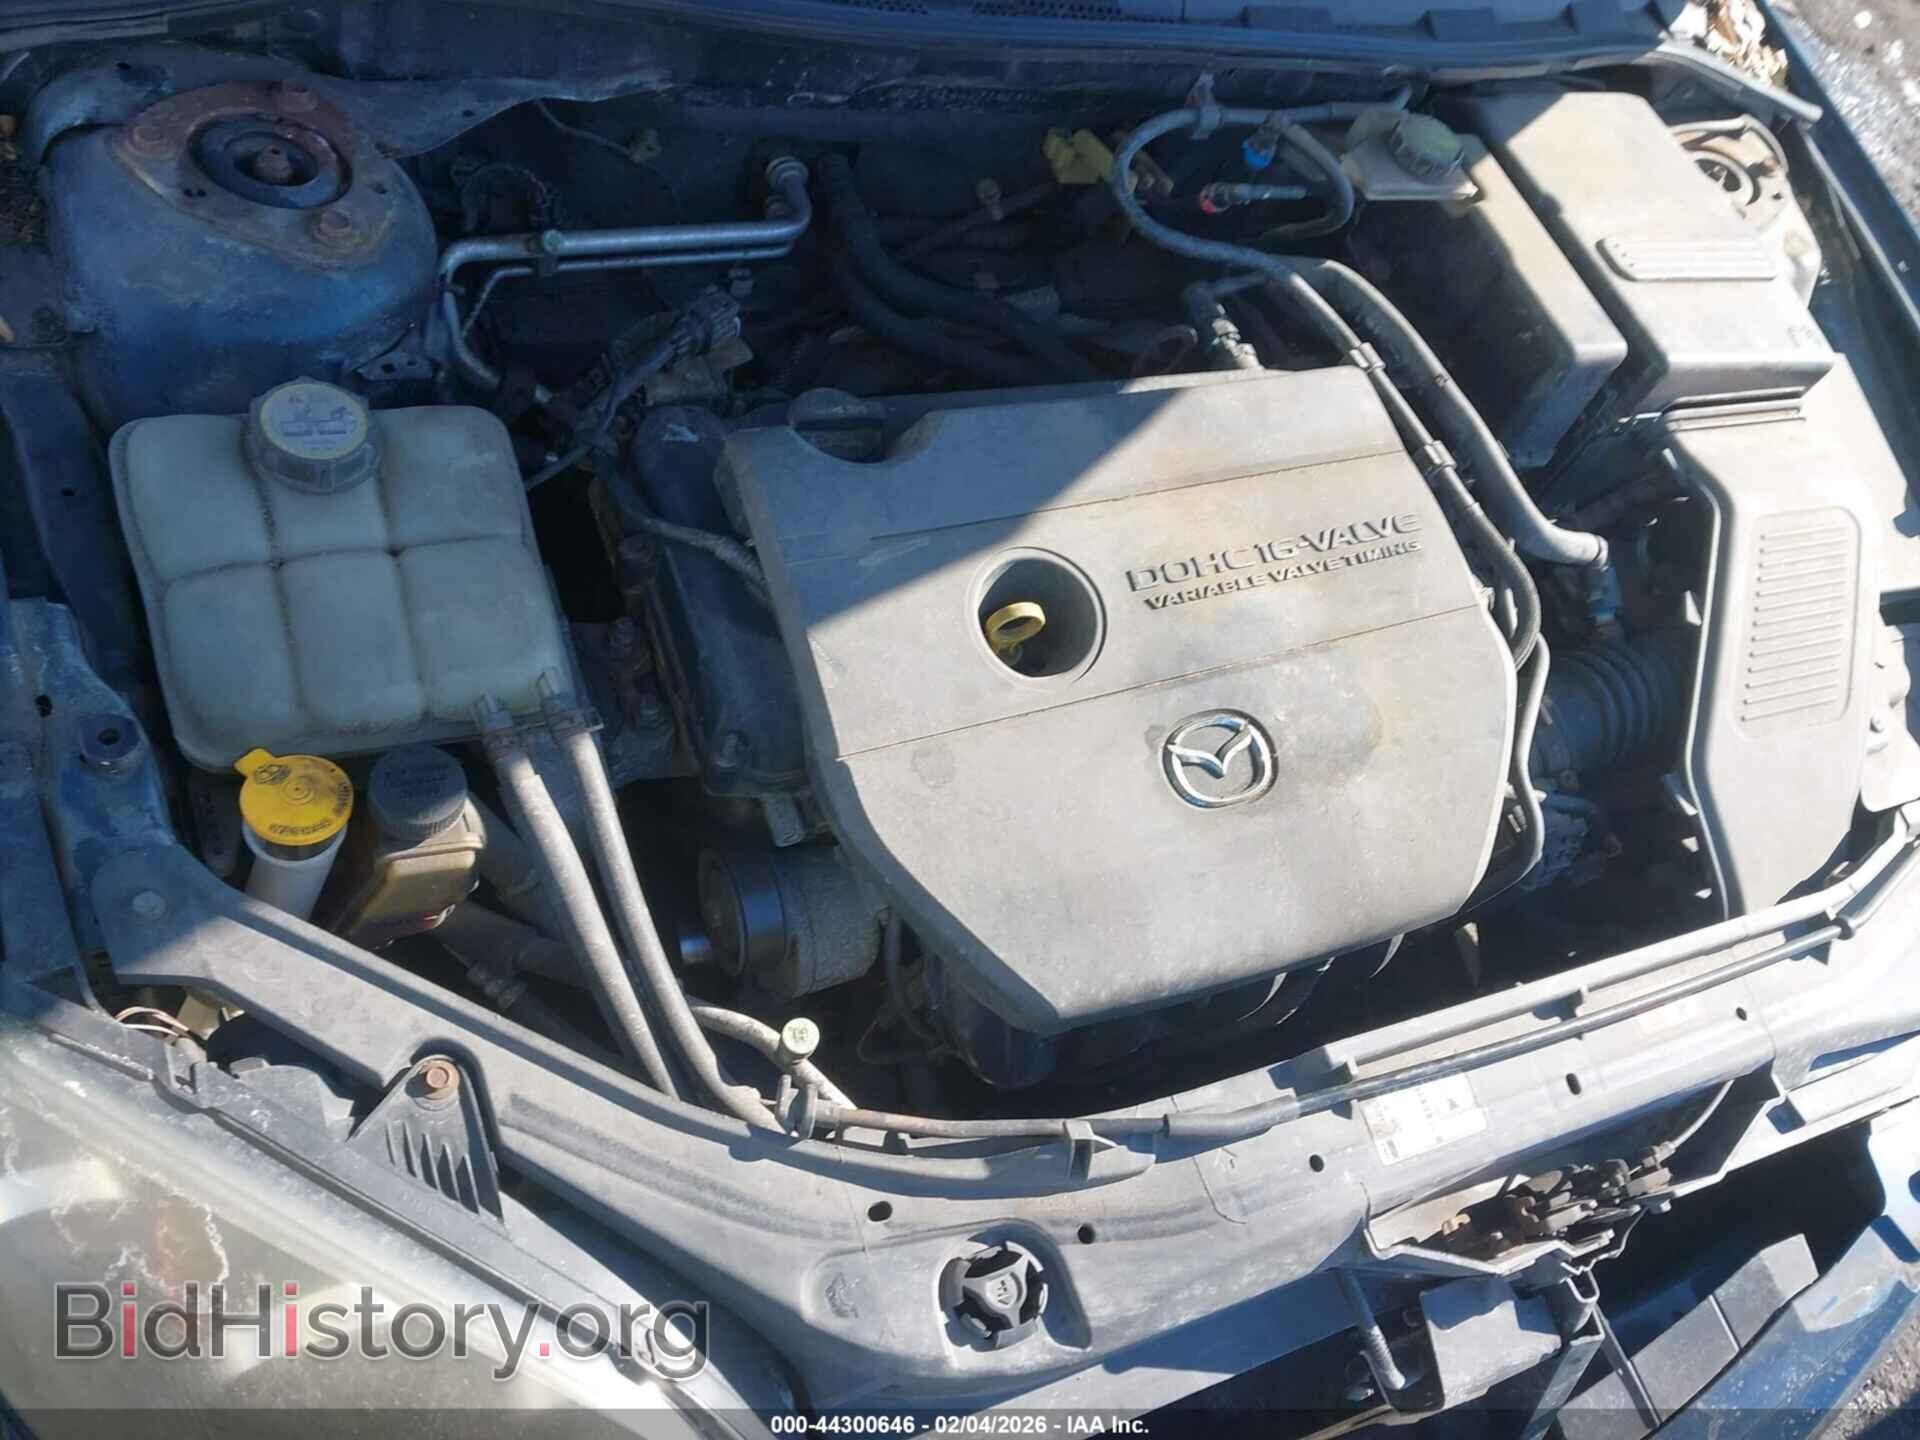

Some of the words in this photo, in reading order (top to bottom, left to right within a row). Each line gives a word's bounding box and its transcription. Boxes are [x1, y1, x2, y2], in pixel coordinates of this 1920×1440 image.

[1125, 548, 1255, 592] DOHC
[1253, 513, 1422, 564] 16-VALVE
[1143, 573, 1266, 610] VARIABLE
[1267, 556, 1343, 583] VALVE
[1340, 540, 1422, 567] TIMING
